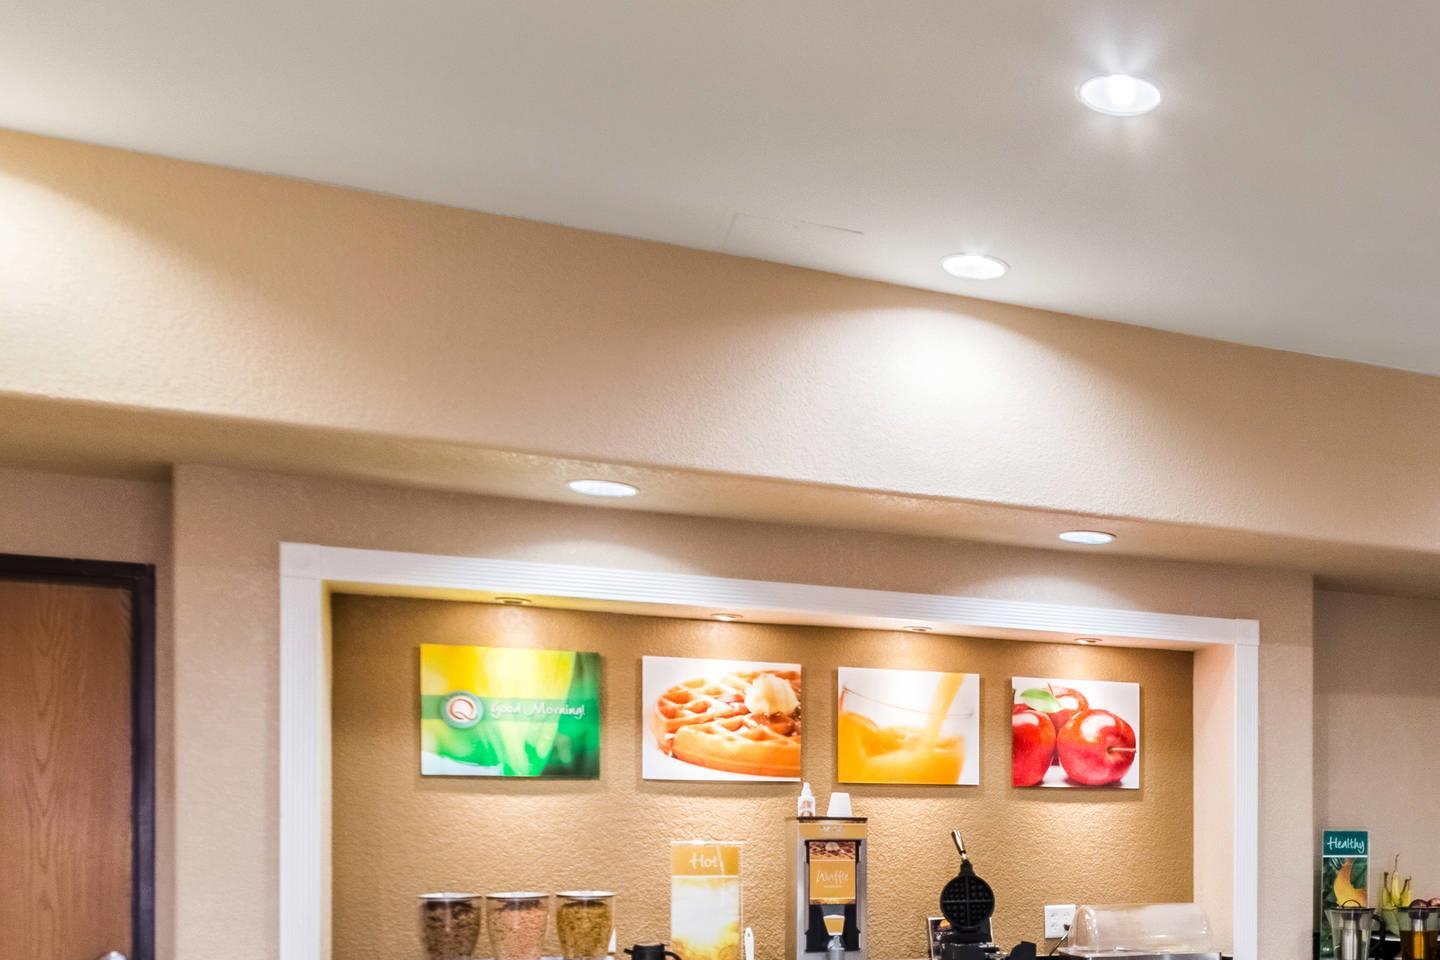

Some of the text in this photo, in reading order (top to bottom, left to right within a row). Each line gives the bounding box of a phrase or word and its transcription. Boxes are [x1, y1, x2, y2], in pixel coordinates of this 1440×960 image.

[449, 698, 476, 721] Q
[490, 700, 585, 720] Good Morning!
[1326, 836, 1366, 854] Healthy
